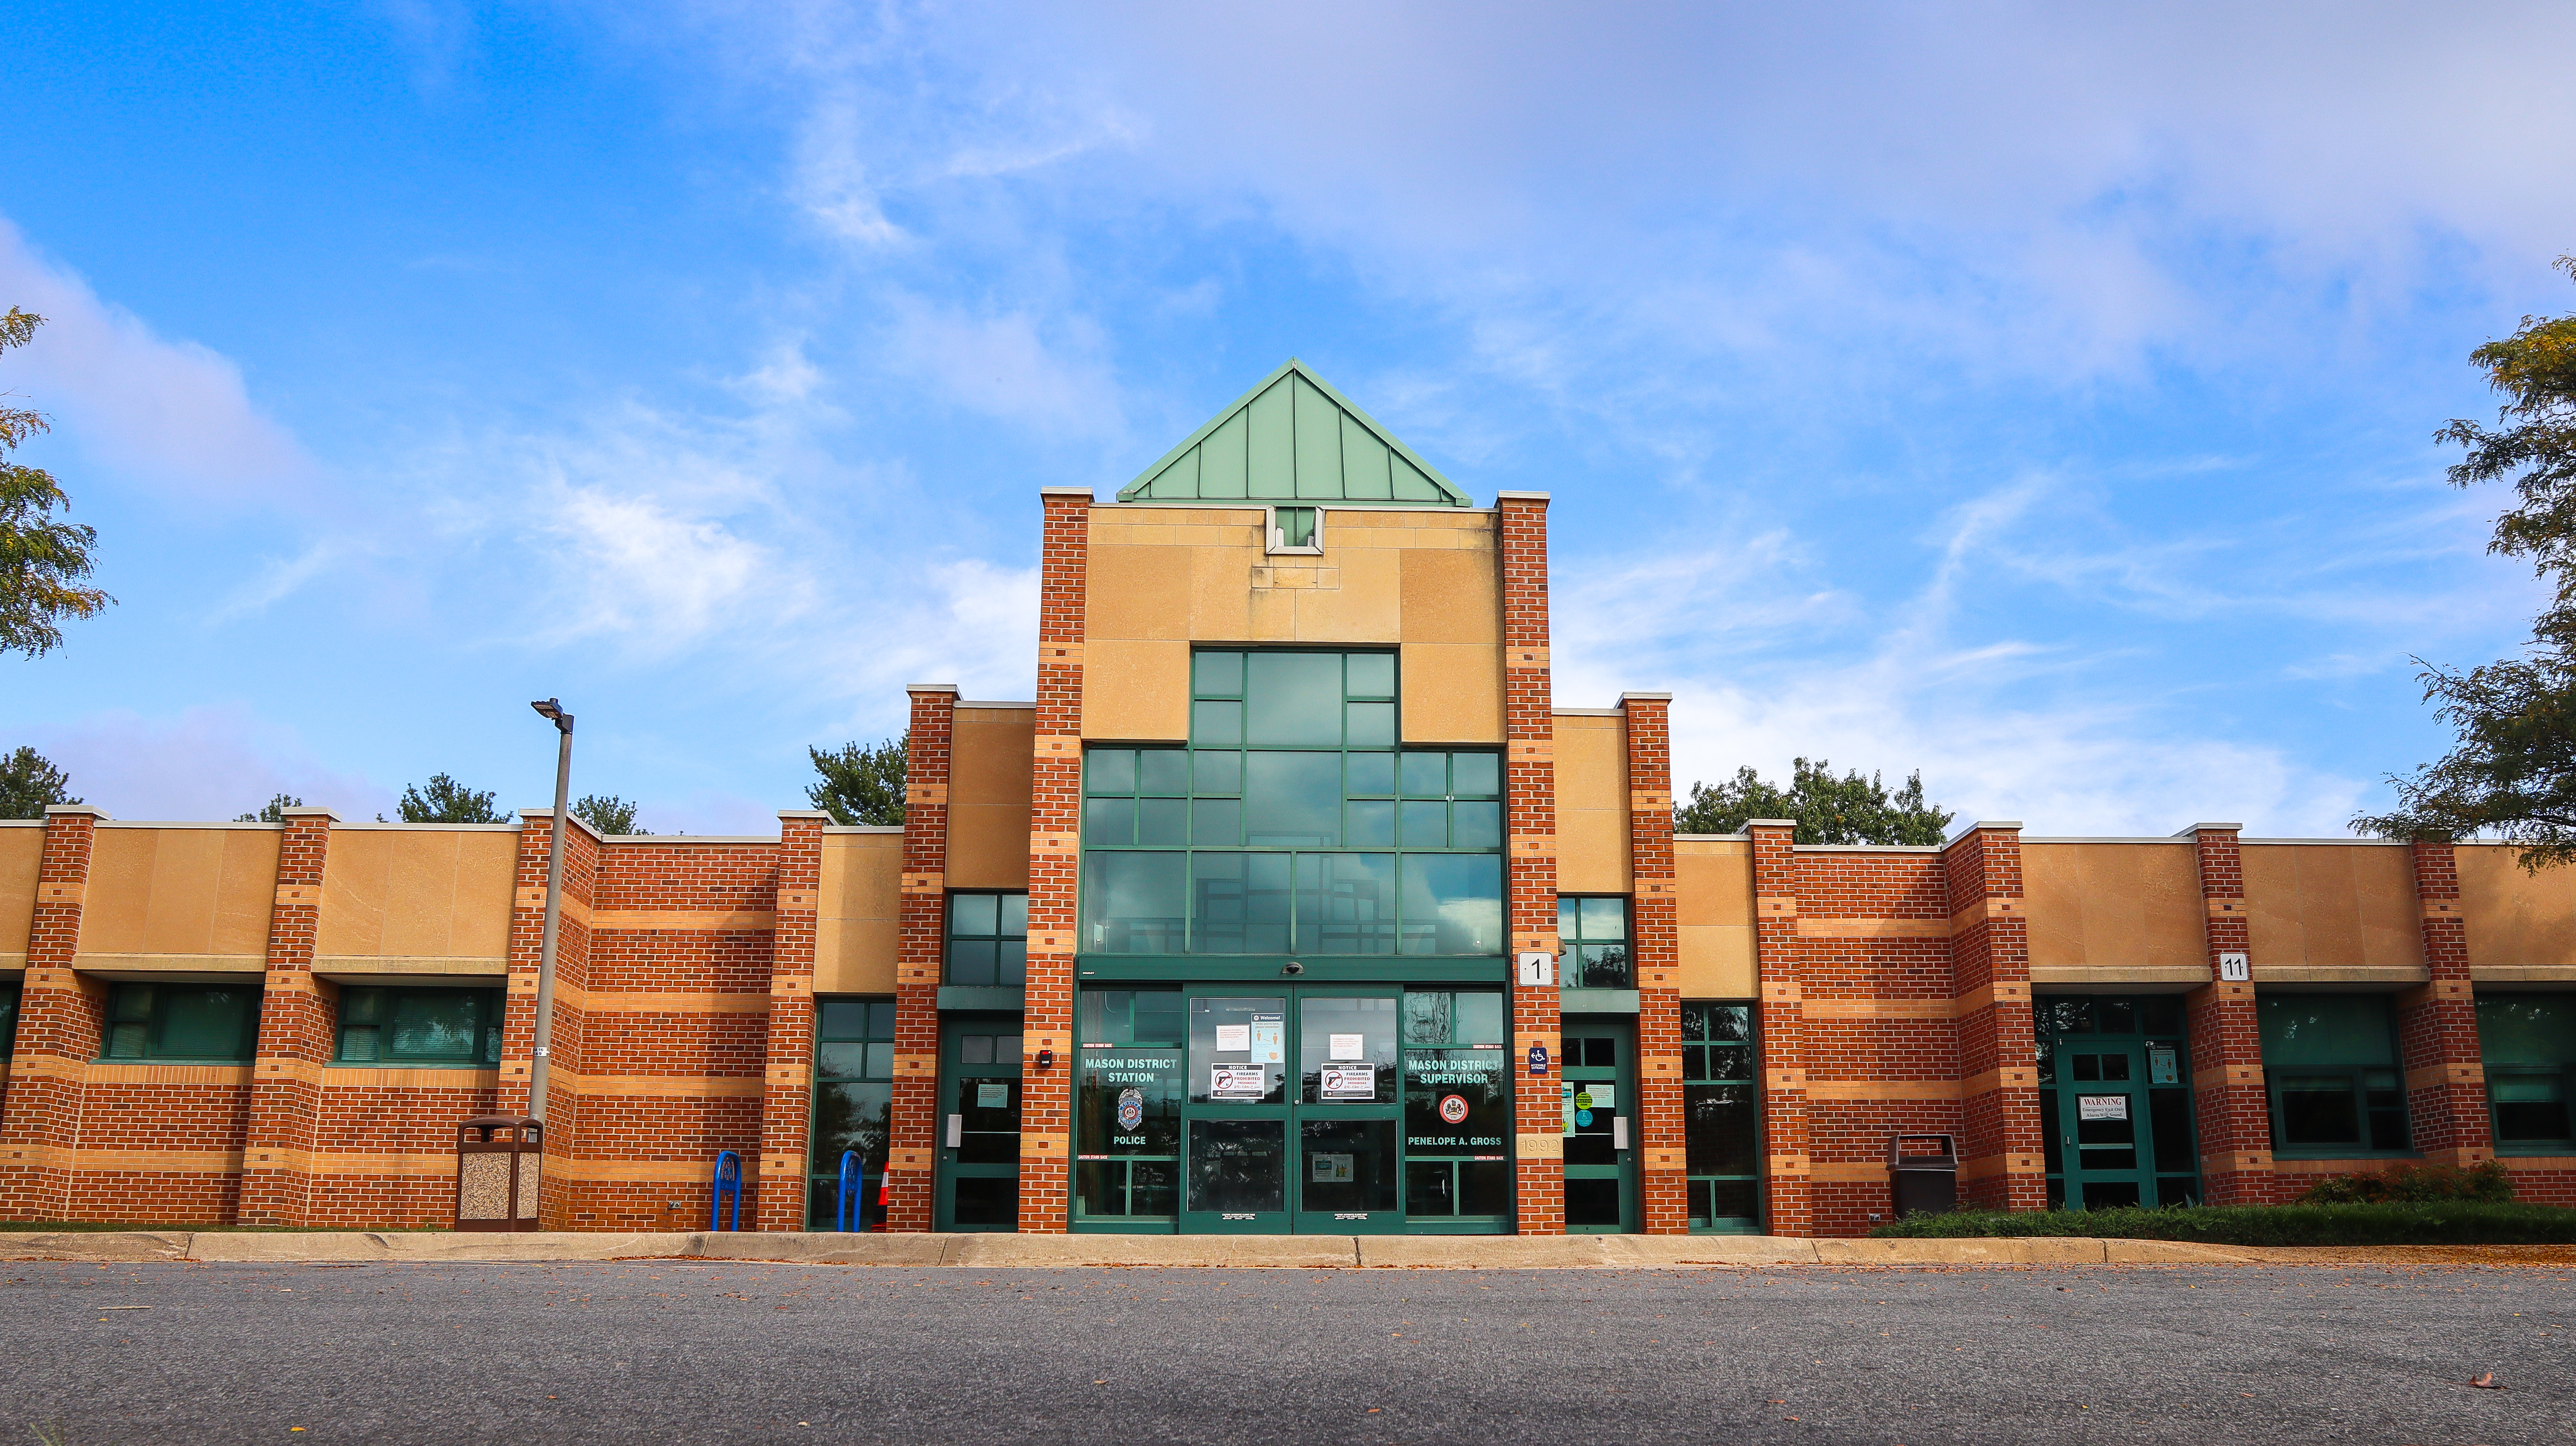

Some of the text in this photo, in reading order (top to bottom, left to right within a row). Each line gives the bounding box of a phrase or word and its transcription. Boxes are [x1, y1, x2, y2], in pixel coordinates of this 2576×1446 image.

[1532, 959, 1540, 979] 1
[2225, 958, 2242, 975] 11
[1085, 1059, 1177, 1068] MASON DISTRICT
[1408, 1060, 1498, 1070] MASON DISTRICT
[1108, 1073, 1154, 1082] STATION
[1420, 1074, 1488, 1084] SUPERVISOR
[1114, 1136, 1146, 1145] POLICE
[1521, 1140, 1559, 1153] 1992
